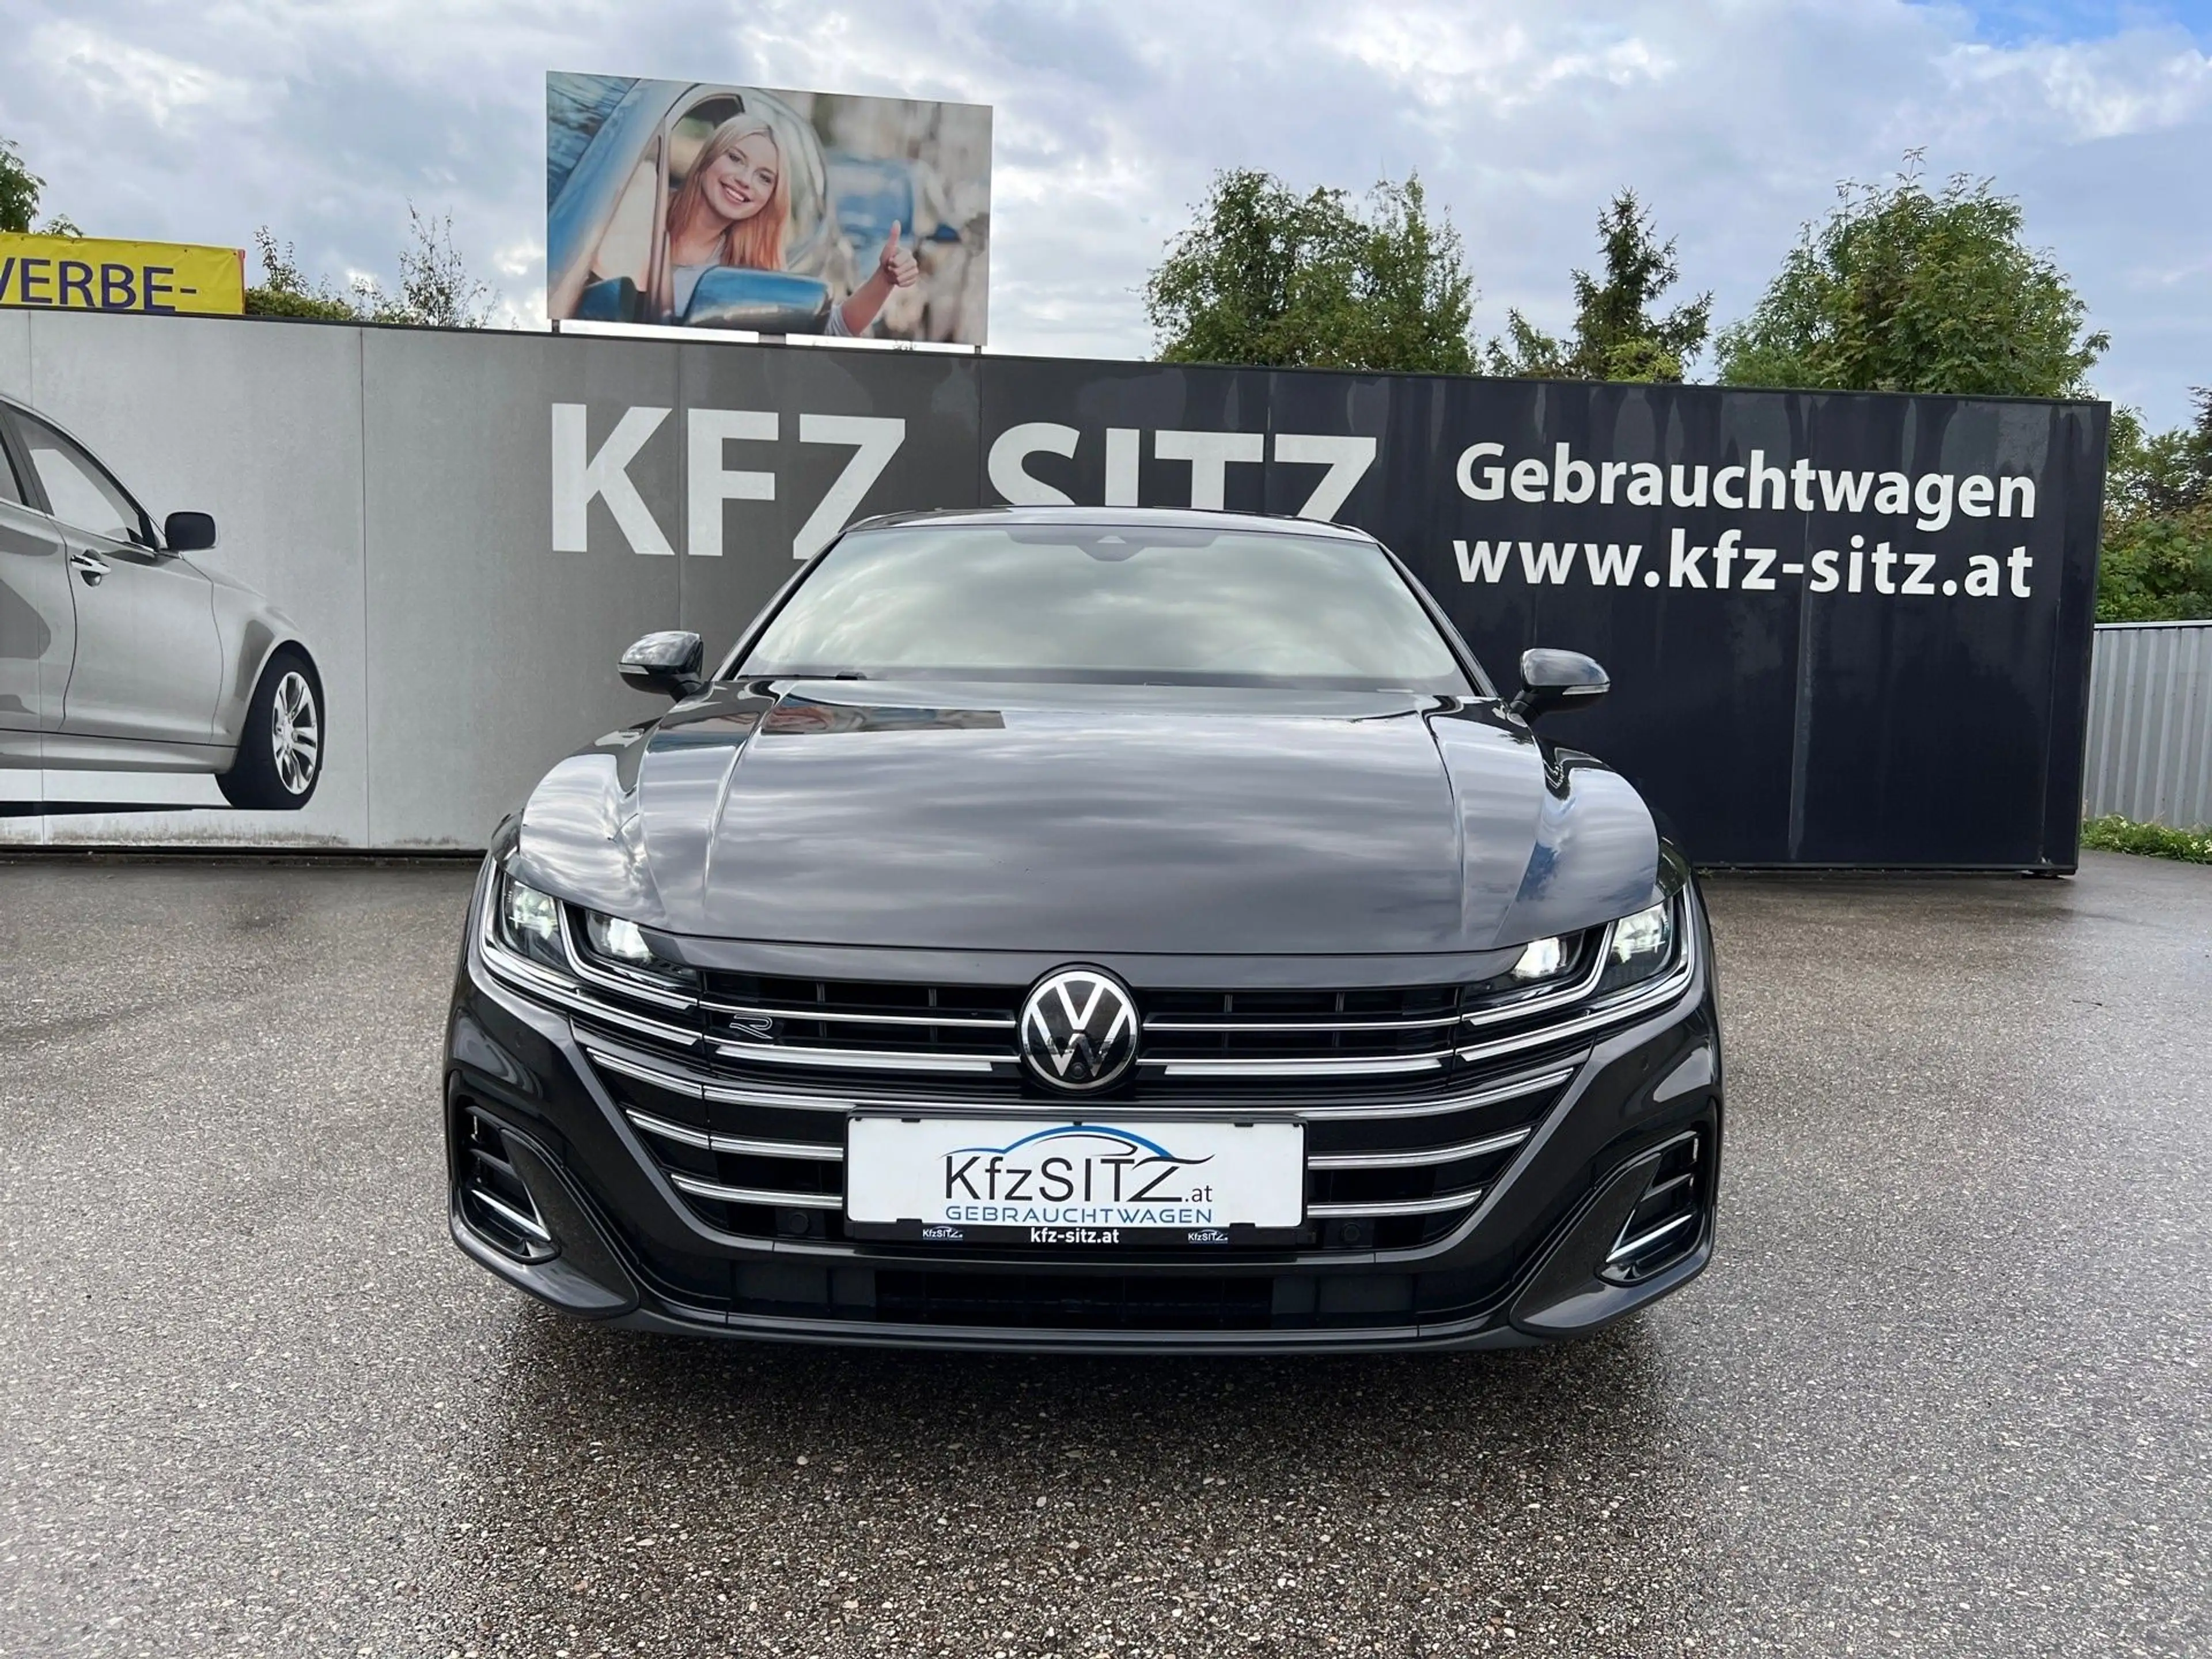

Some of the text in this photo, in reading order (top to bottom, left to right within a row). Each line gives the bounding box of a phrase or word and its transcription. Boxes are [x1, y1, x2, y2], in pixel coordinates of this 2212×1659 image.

[551, 403, 1377, 560] KFZ SITZ
[1456, 442, 2036, 532] Gebrauchtwagen
[1453, 528, 2033, 599] www.kfz-sitz.at
[945, 1206, 1212, 1224] GEBRAUCHTWAGEN
[1031, 1226, 1120, 1244] kfz-sitz.at
